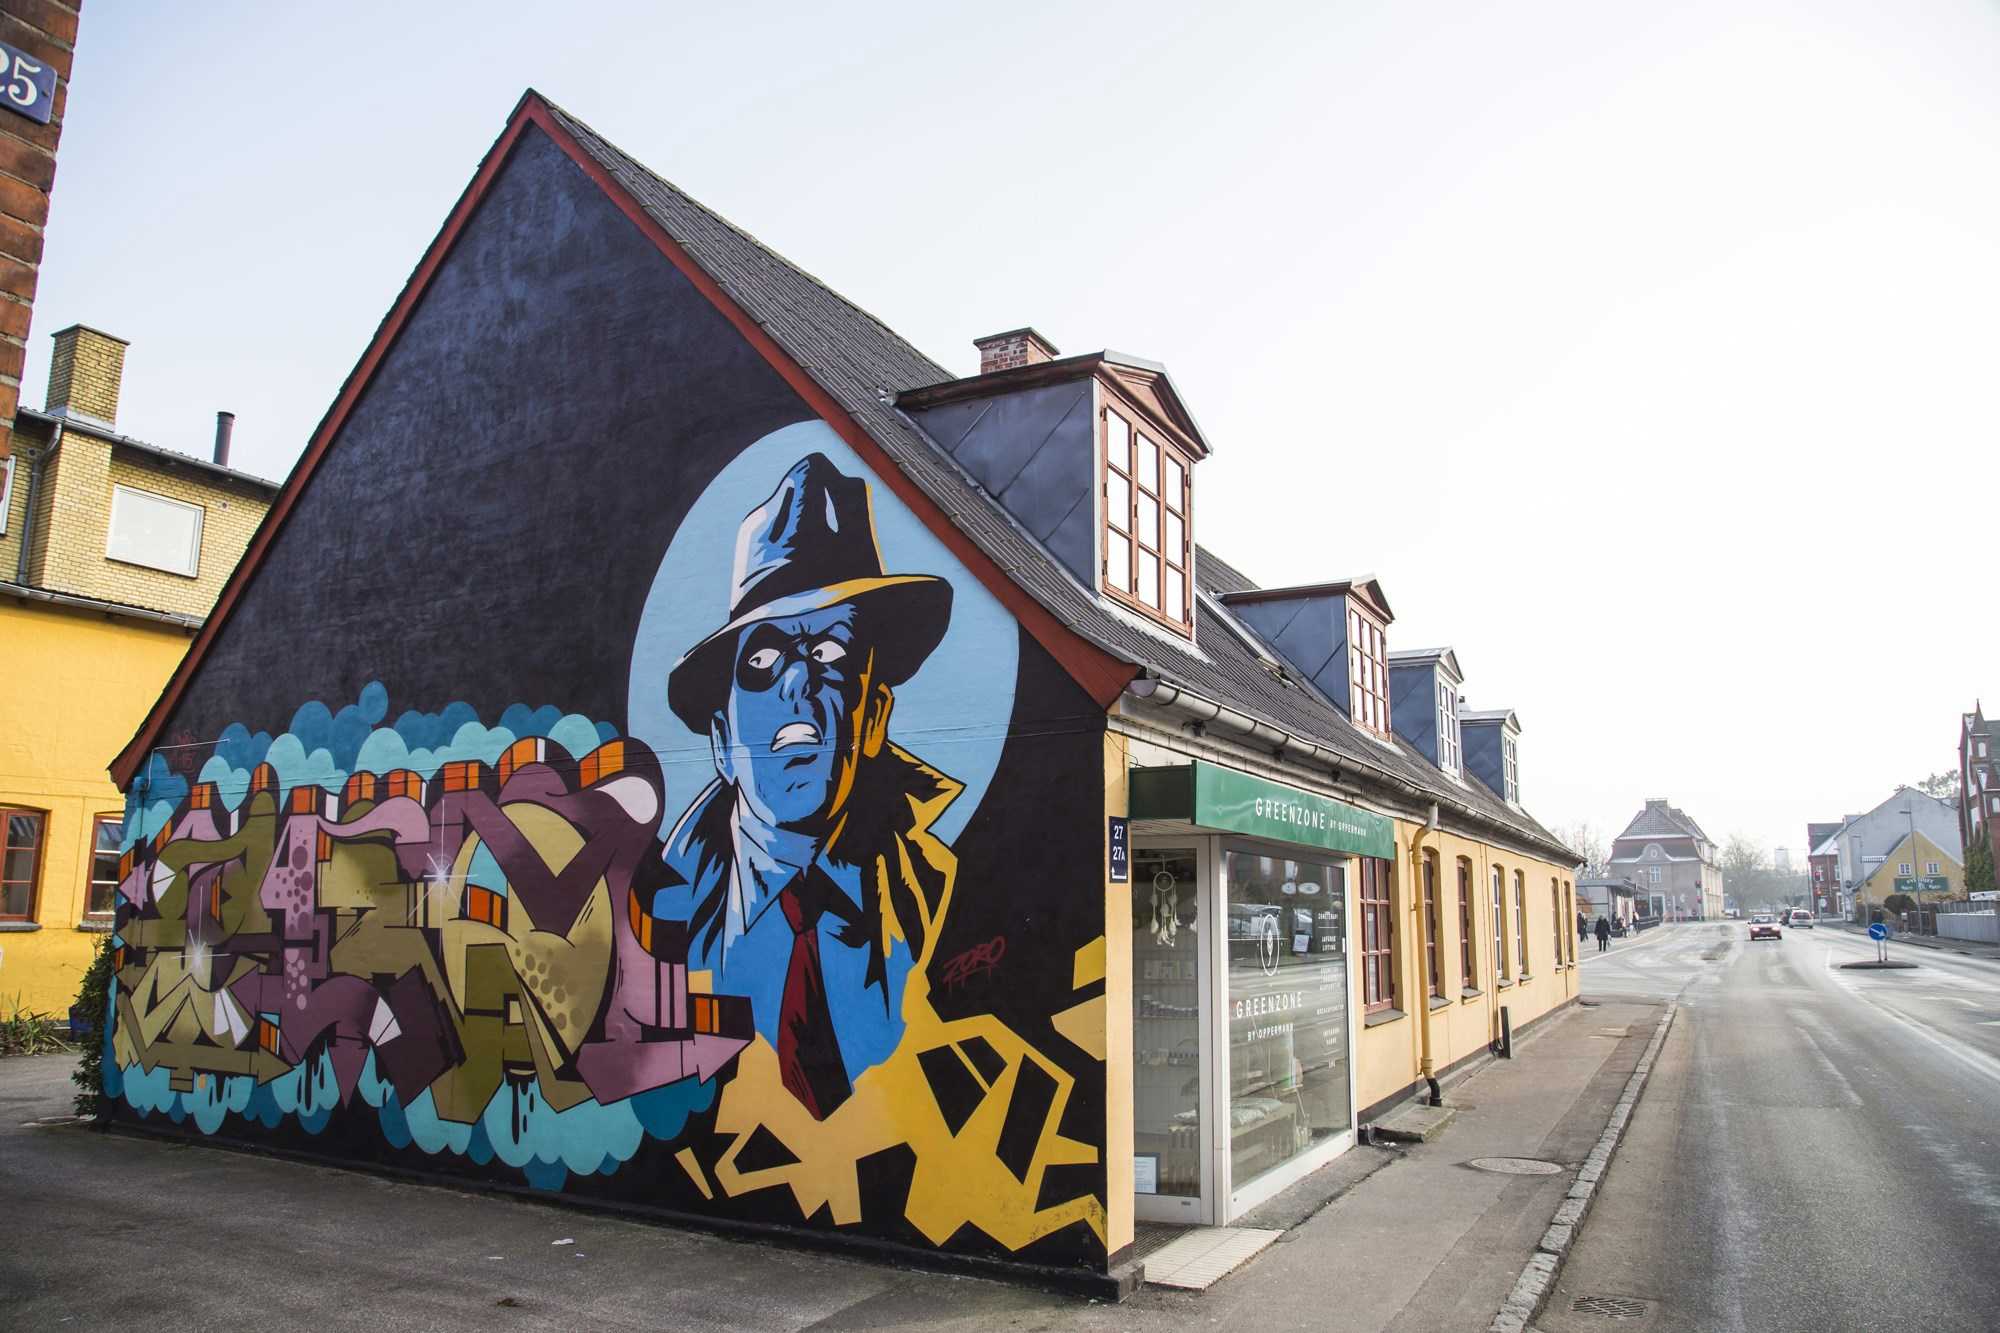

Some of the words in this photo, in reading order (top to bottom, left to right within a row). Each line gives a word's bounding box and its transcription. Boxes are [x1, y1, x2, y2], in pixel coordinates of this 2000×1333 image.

[1255, 797, 1325, 830] GREENZONE
[1114, 825, 1124, 840] 27
[1112, 845, 1126, 861] 27A
[1236, 991, 1303, 1018] GREENZONE
[1247, 1030, 1256, 1041] BY
